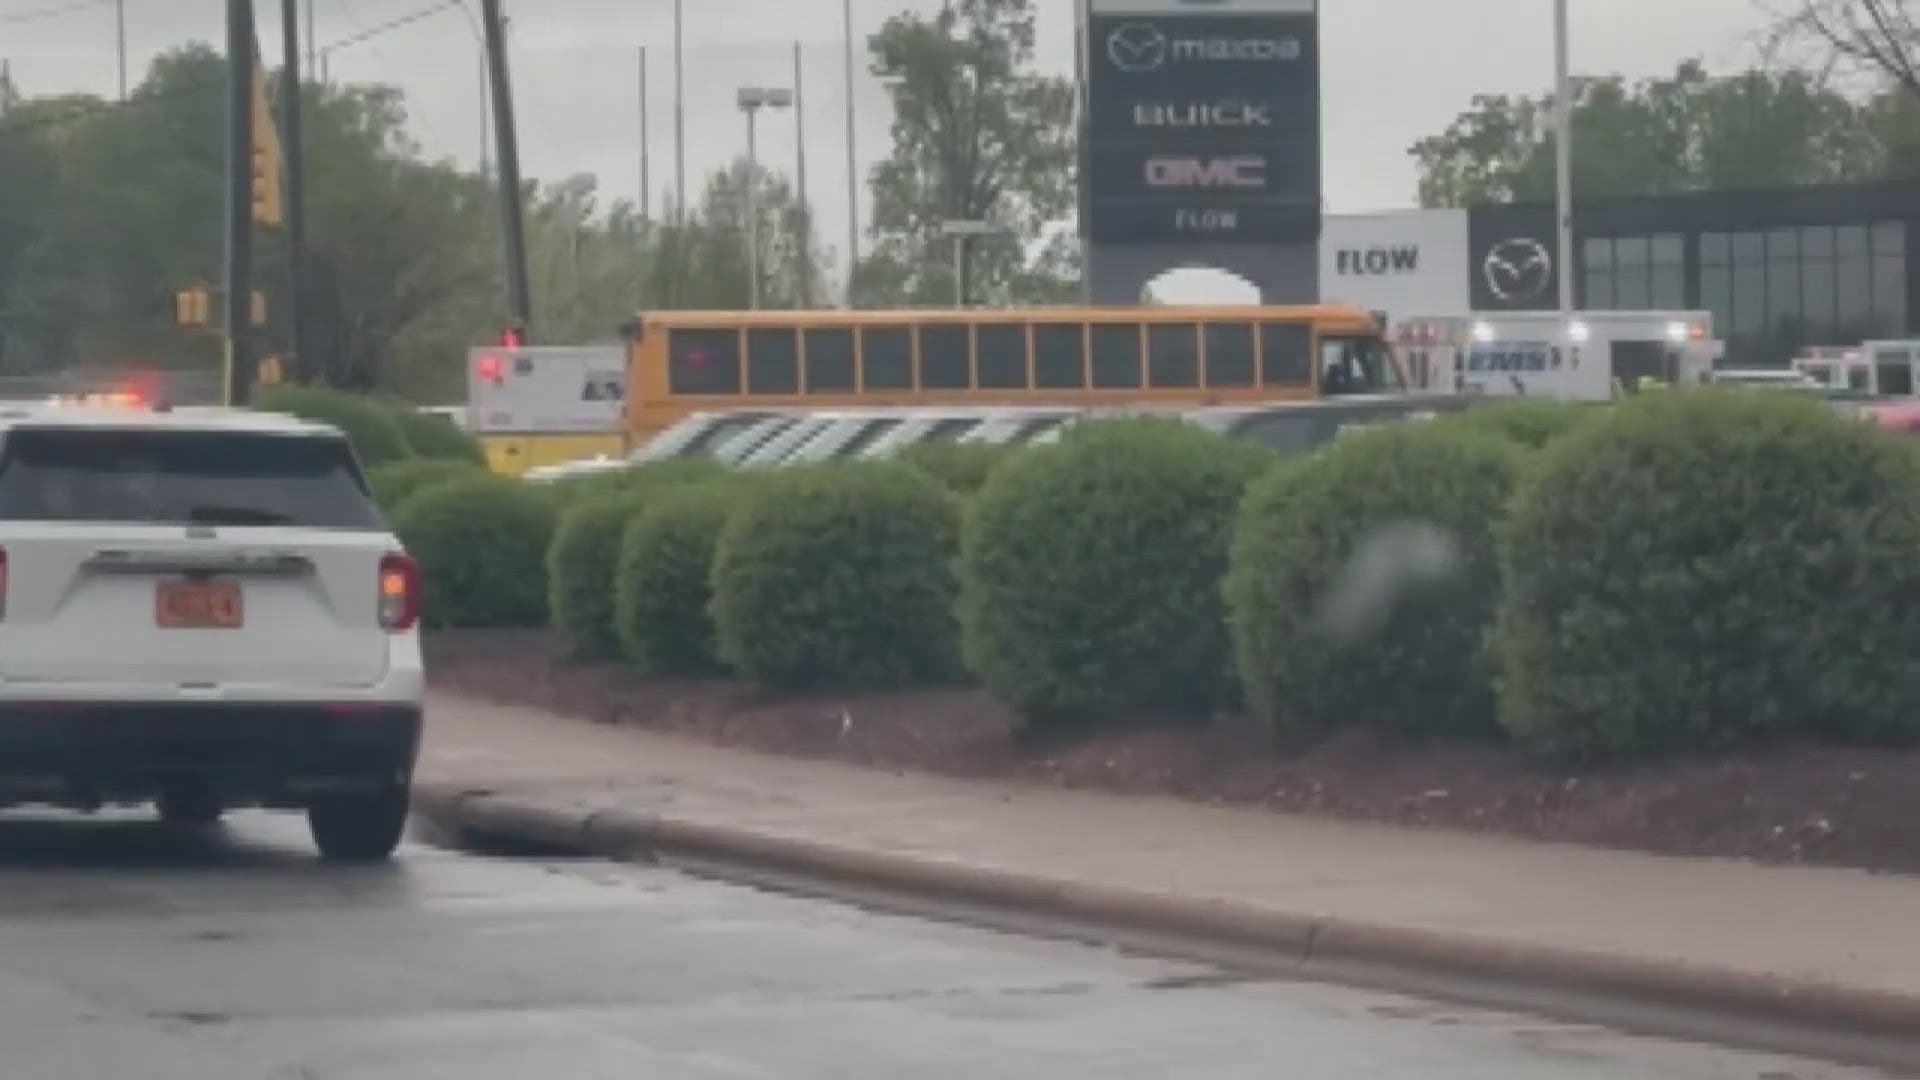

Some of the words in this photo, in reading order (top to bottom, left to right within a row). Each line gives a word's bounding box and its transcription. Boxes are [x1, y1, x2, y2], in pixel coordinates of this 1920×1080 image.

[1173, 36, 1300, 60] mazda
[1134, 103, 1271, 127] BUICK
[1144, 159, 1267, 186] GMC
[1175, 209, 1238, 229] FLOW
[1336, 246, 1418, 275] FLOW
